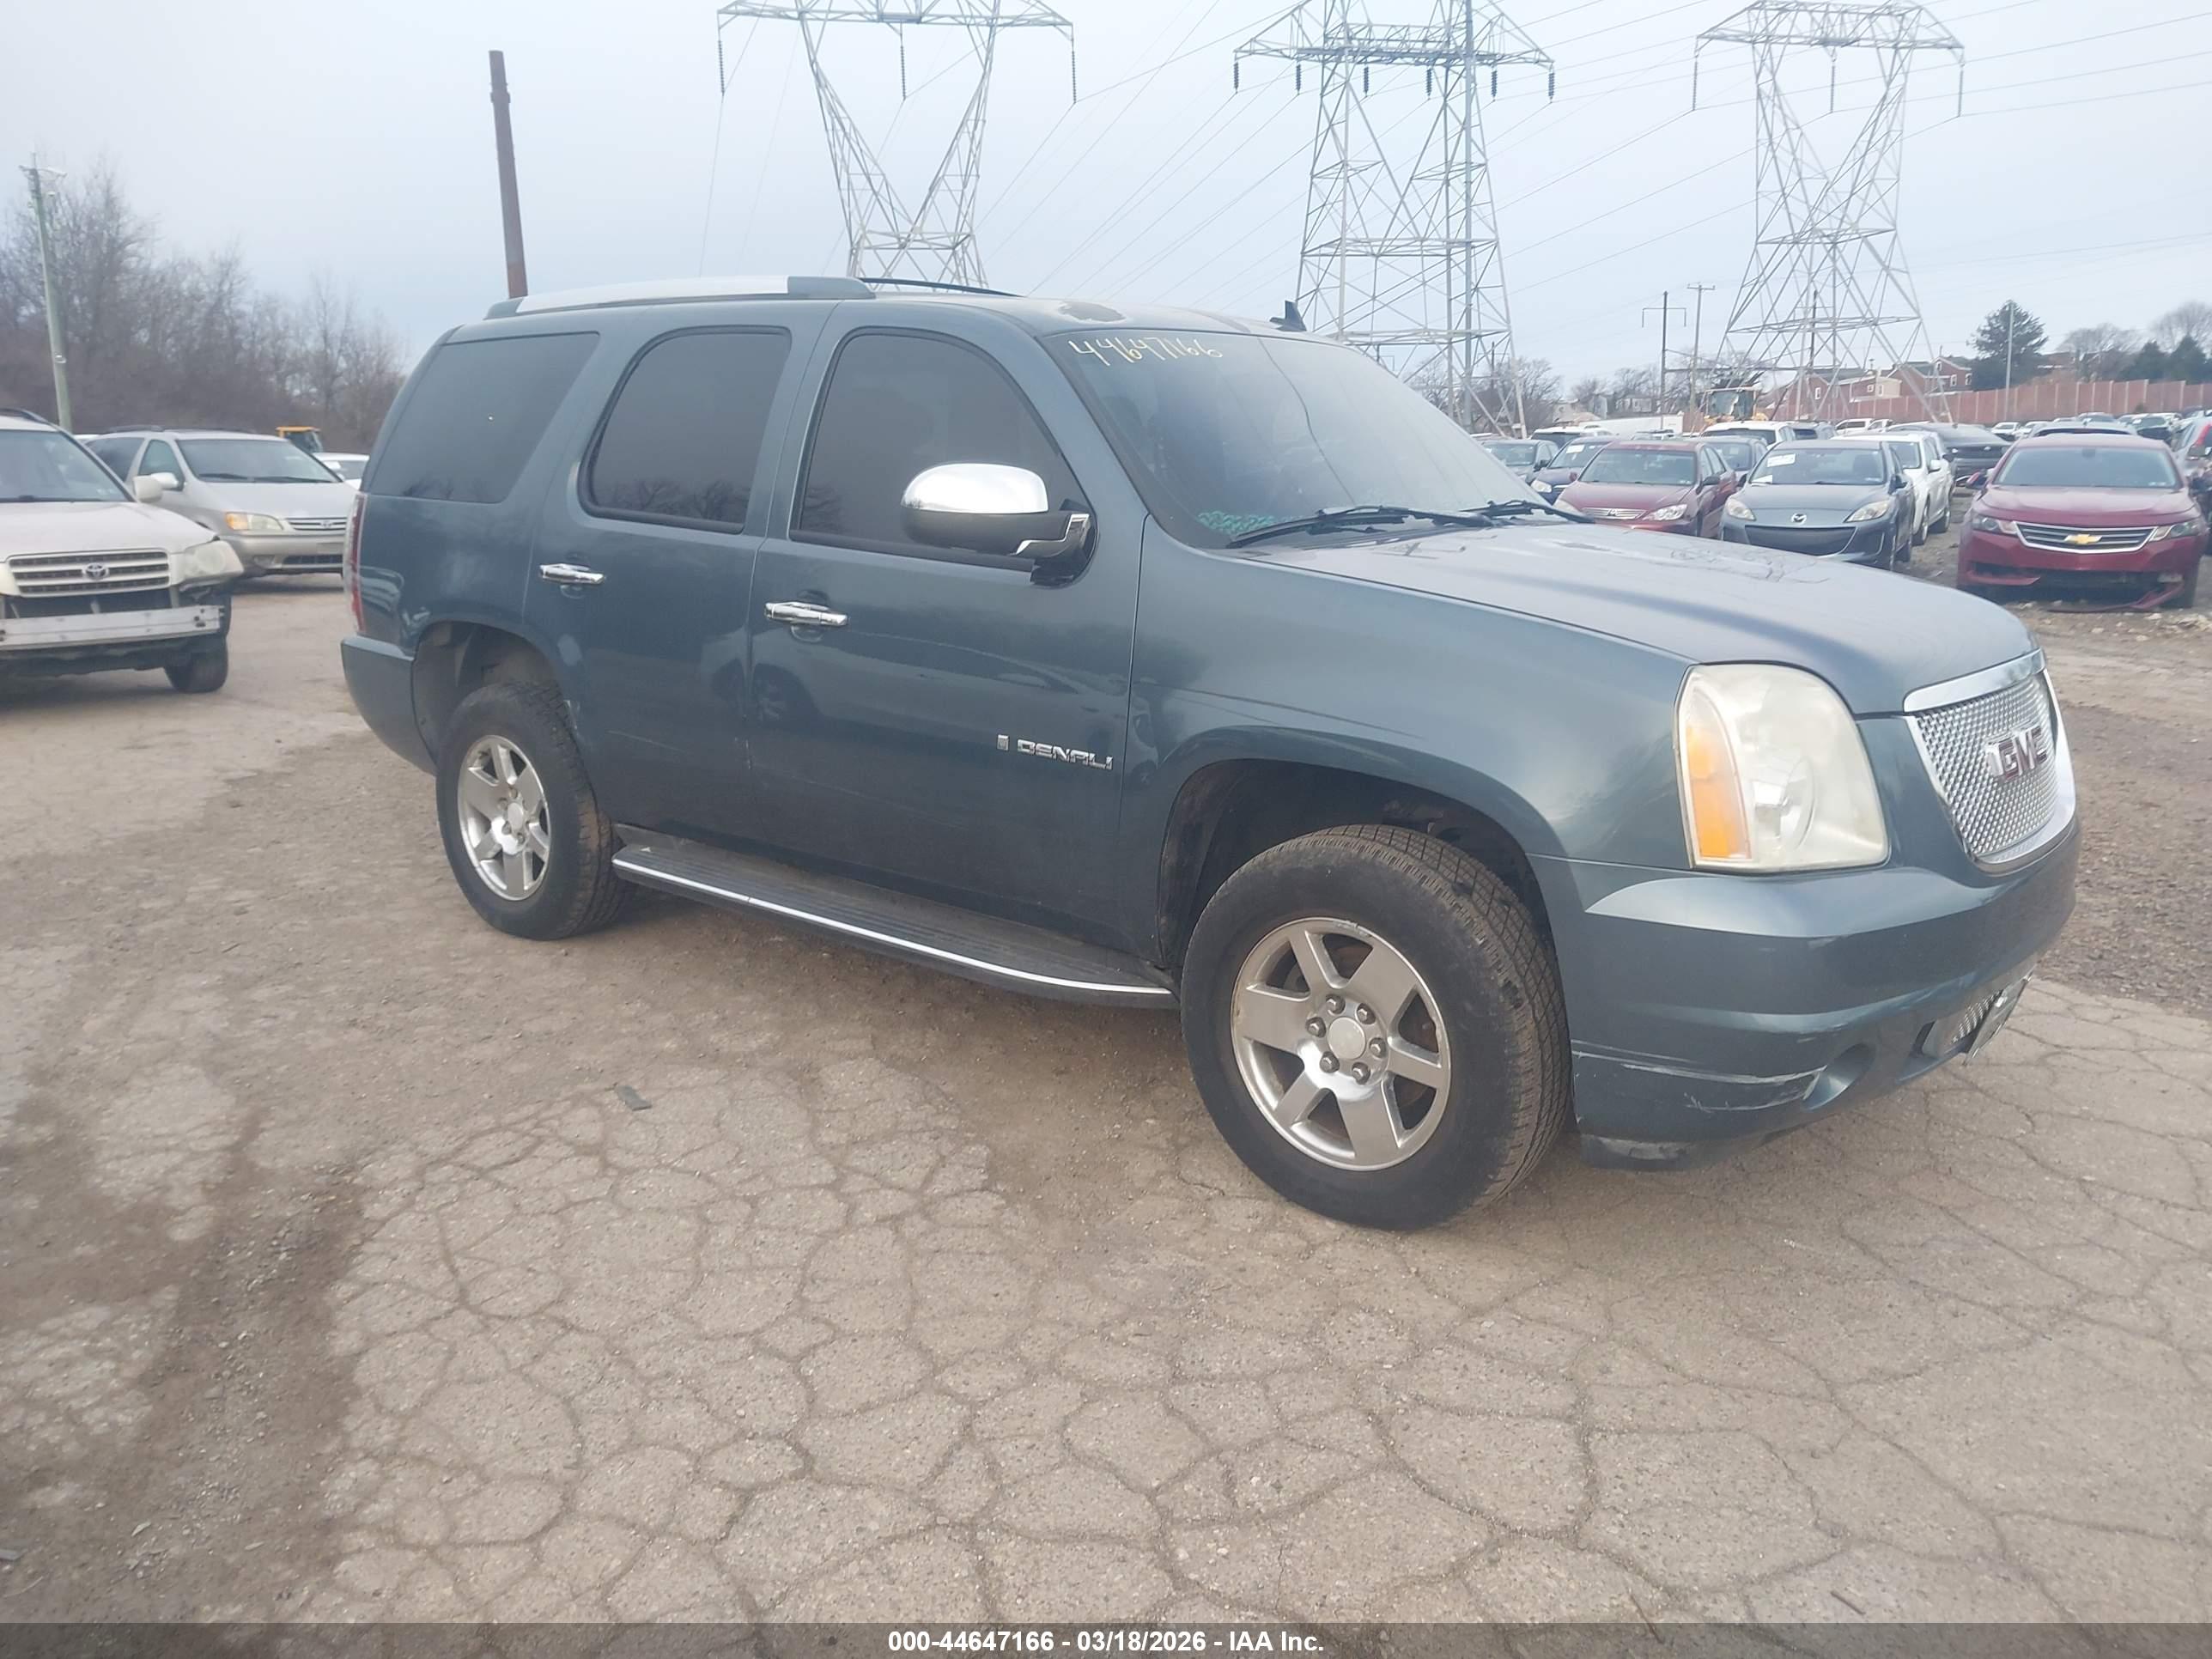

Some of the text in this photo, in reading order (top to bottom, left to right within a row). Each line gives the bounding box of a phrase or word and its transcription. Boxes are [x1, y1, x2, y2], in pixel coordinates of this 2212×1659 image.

[1068, 337, 1223, 366] 44647166
[1017, 738, 1114, 770] DENALI
[1984, 725, 2048, 779] GMC
